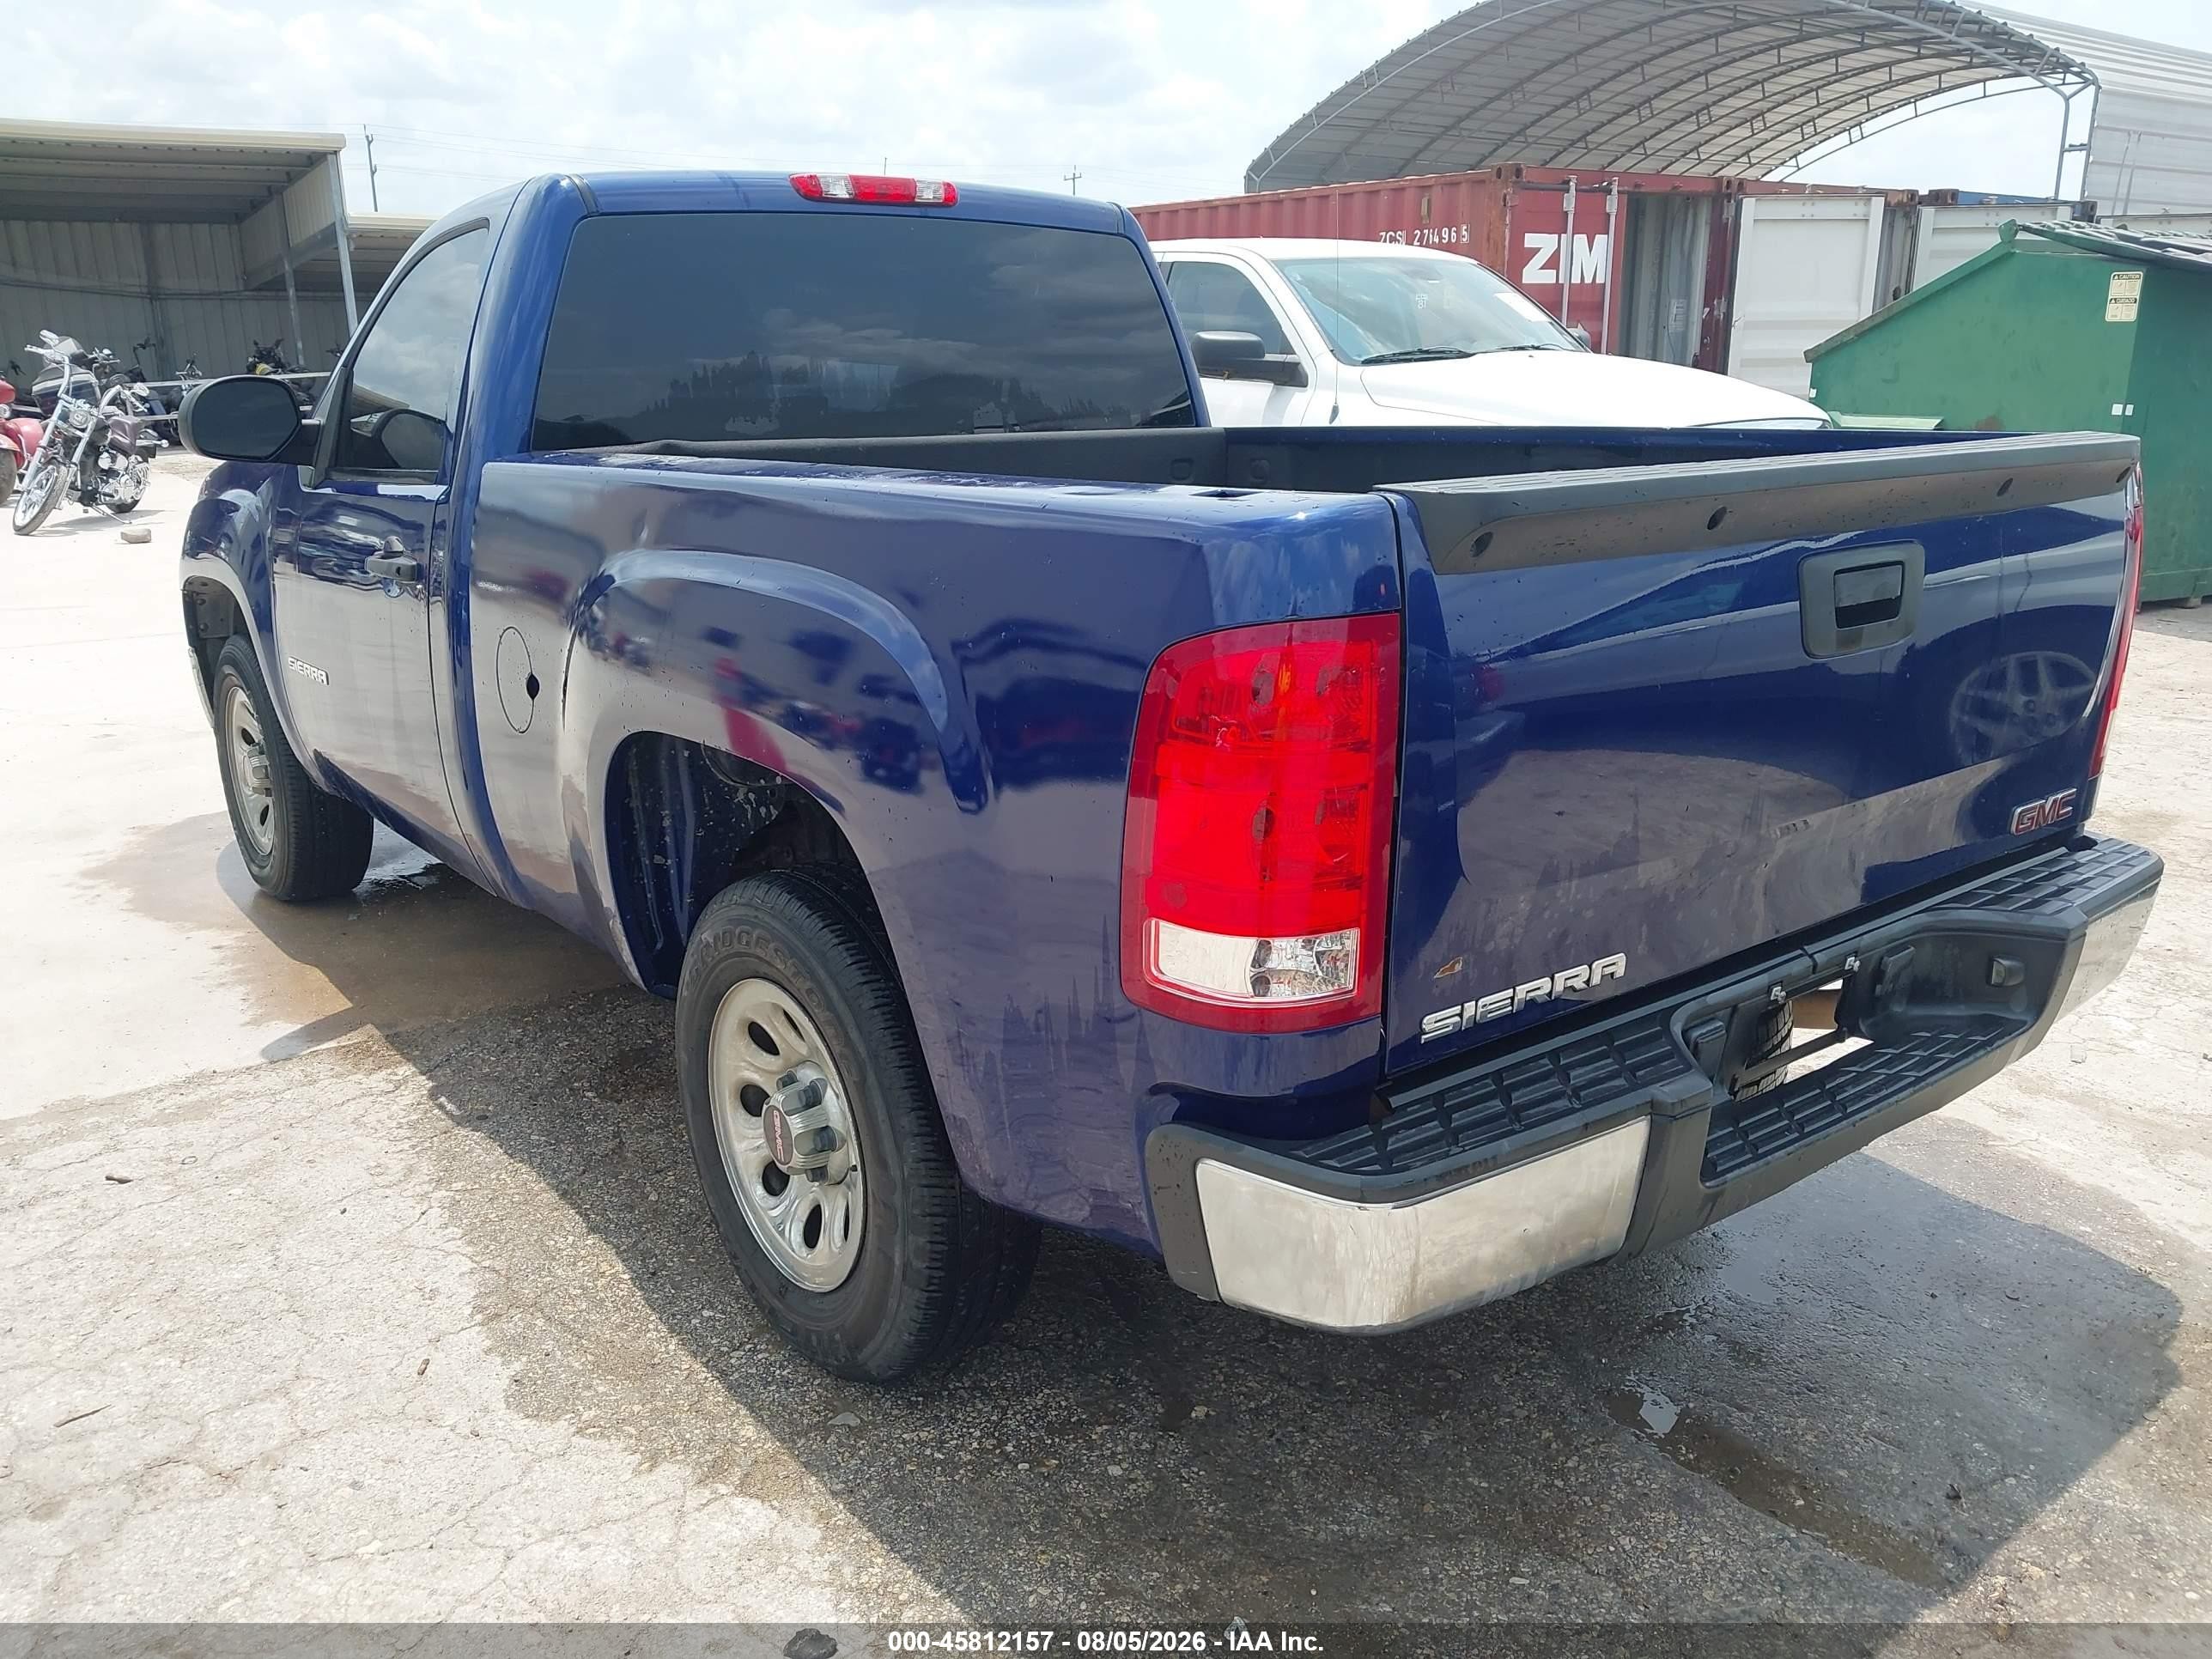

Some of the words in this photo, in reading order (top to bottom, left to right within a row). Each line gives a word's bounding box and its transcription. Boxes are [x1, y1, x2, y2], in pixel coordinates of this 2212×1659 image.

[1522, 233, 1607, 283] ZIM
[289, 656, 329, 685] SIERRA
[2010, 787, 2077, 836] GMC
[1420, 952, 1627, 1044] SIERRA
